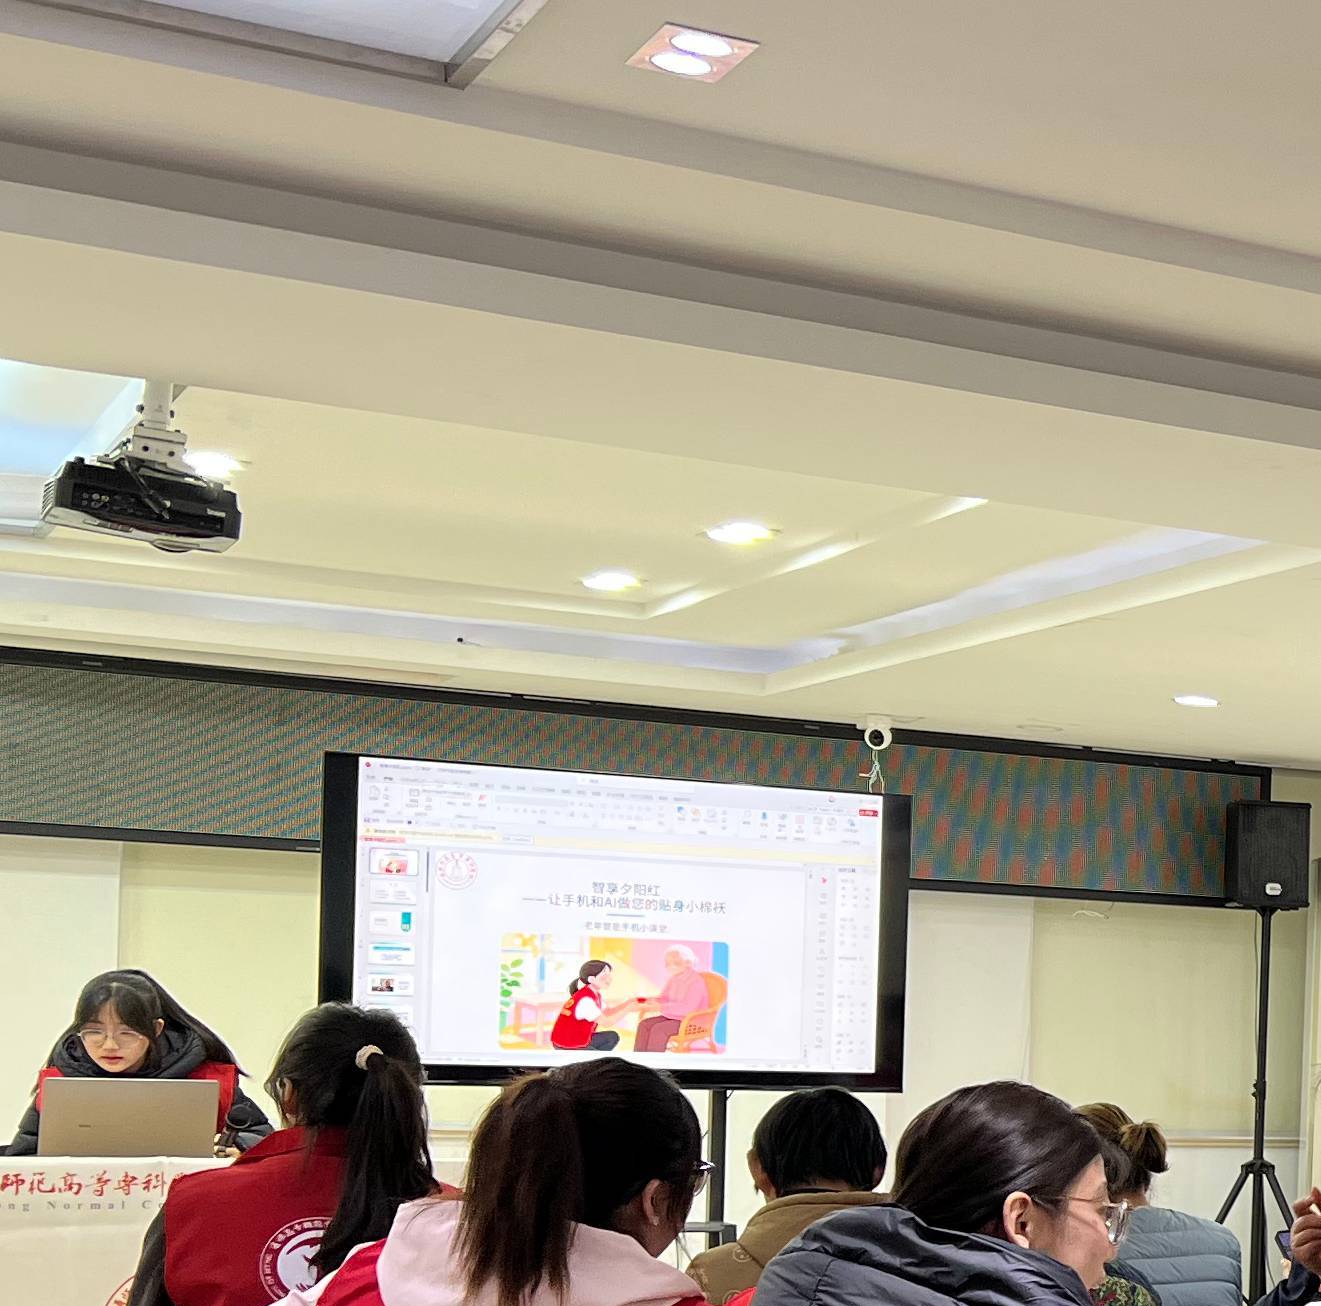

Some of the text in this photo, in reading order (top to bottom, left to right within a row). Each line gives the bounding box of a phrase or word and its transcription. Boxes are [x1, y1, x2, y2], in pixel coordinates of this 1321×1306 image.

[592, 881, 661, 897] 智享夕阳红
[47, 1200, 126, 1211] Normal
